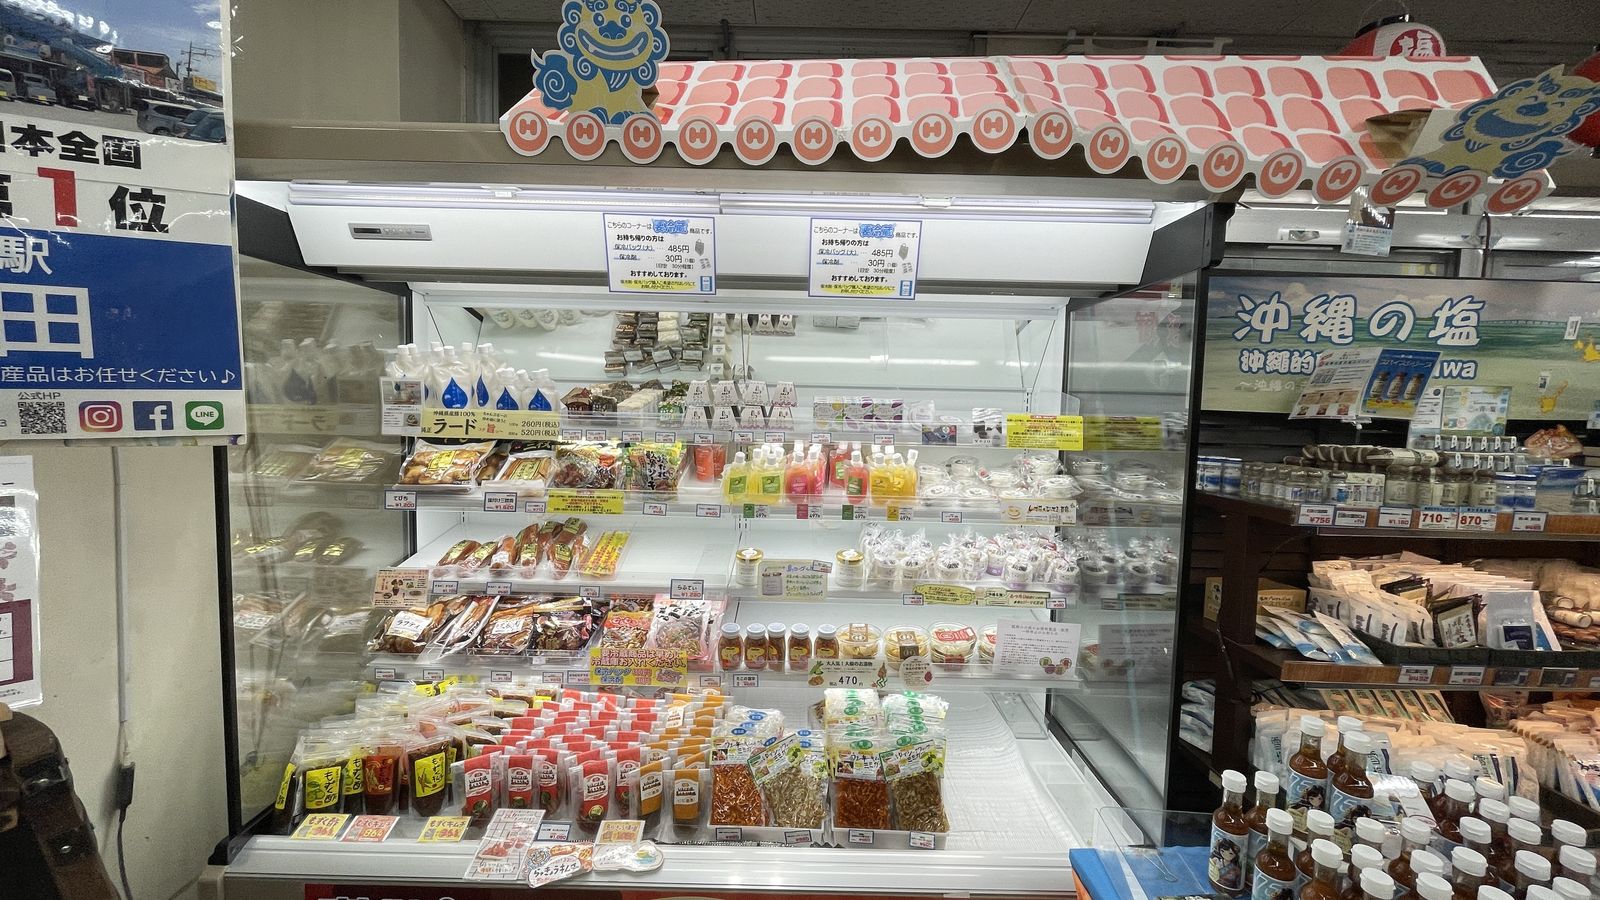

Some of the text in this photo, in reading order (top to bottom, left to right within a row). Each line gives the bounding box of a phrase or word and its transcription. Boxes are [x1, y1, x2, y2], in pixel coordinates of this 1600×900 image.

[0, 121, 141, 170] 本全国
[607, 221, 652, 230] こちらのコーナーは
[813, 226, 859, 234] こちらのコーナーは
[616, 234, 664, 242] お持ち帰りの方は
[821, 239, 869, 247] お持ち帰りの方は
[667, 245, 690, 253] 485円
[871, 249, 893, 258] 485円
[665, 255, 683, 263] 30円
[868, 259, 885, 267] 30円
[630, 270, 688, 278] おすすめしております。
[831, 275, 888, 283] おすすめしております。
[0, 283, 94, 359] 田
[1233, 293, 1486, 347] 沖縄の塩
[17, 391, 62, 401] 公式HP
[195, 410, 215, 418] LINE
[433, 418, 478, 435] ラード
[521, 420, 560, 428] 260円(税込)
[520, 429, 560, 437] 520円(税込)
[838, 676, 858, 685] 470
[308, 816, 339, 828] もずく酢
[429, 820, 466, 829] もずくキムチ
